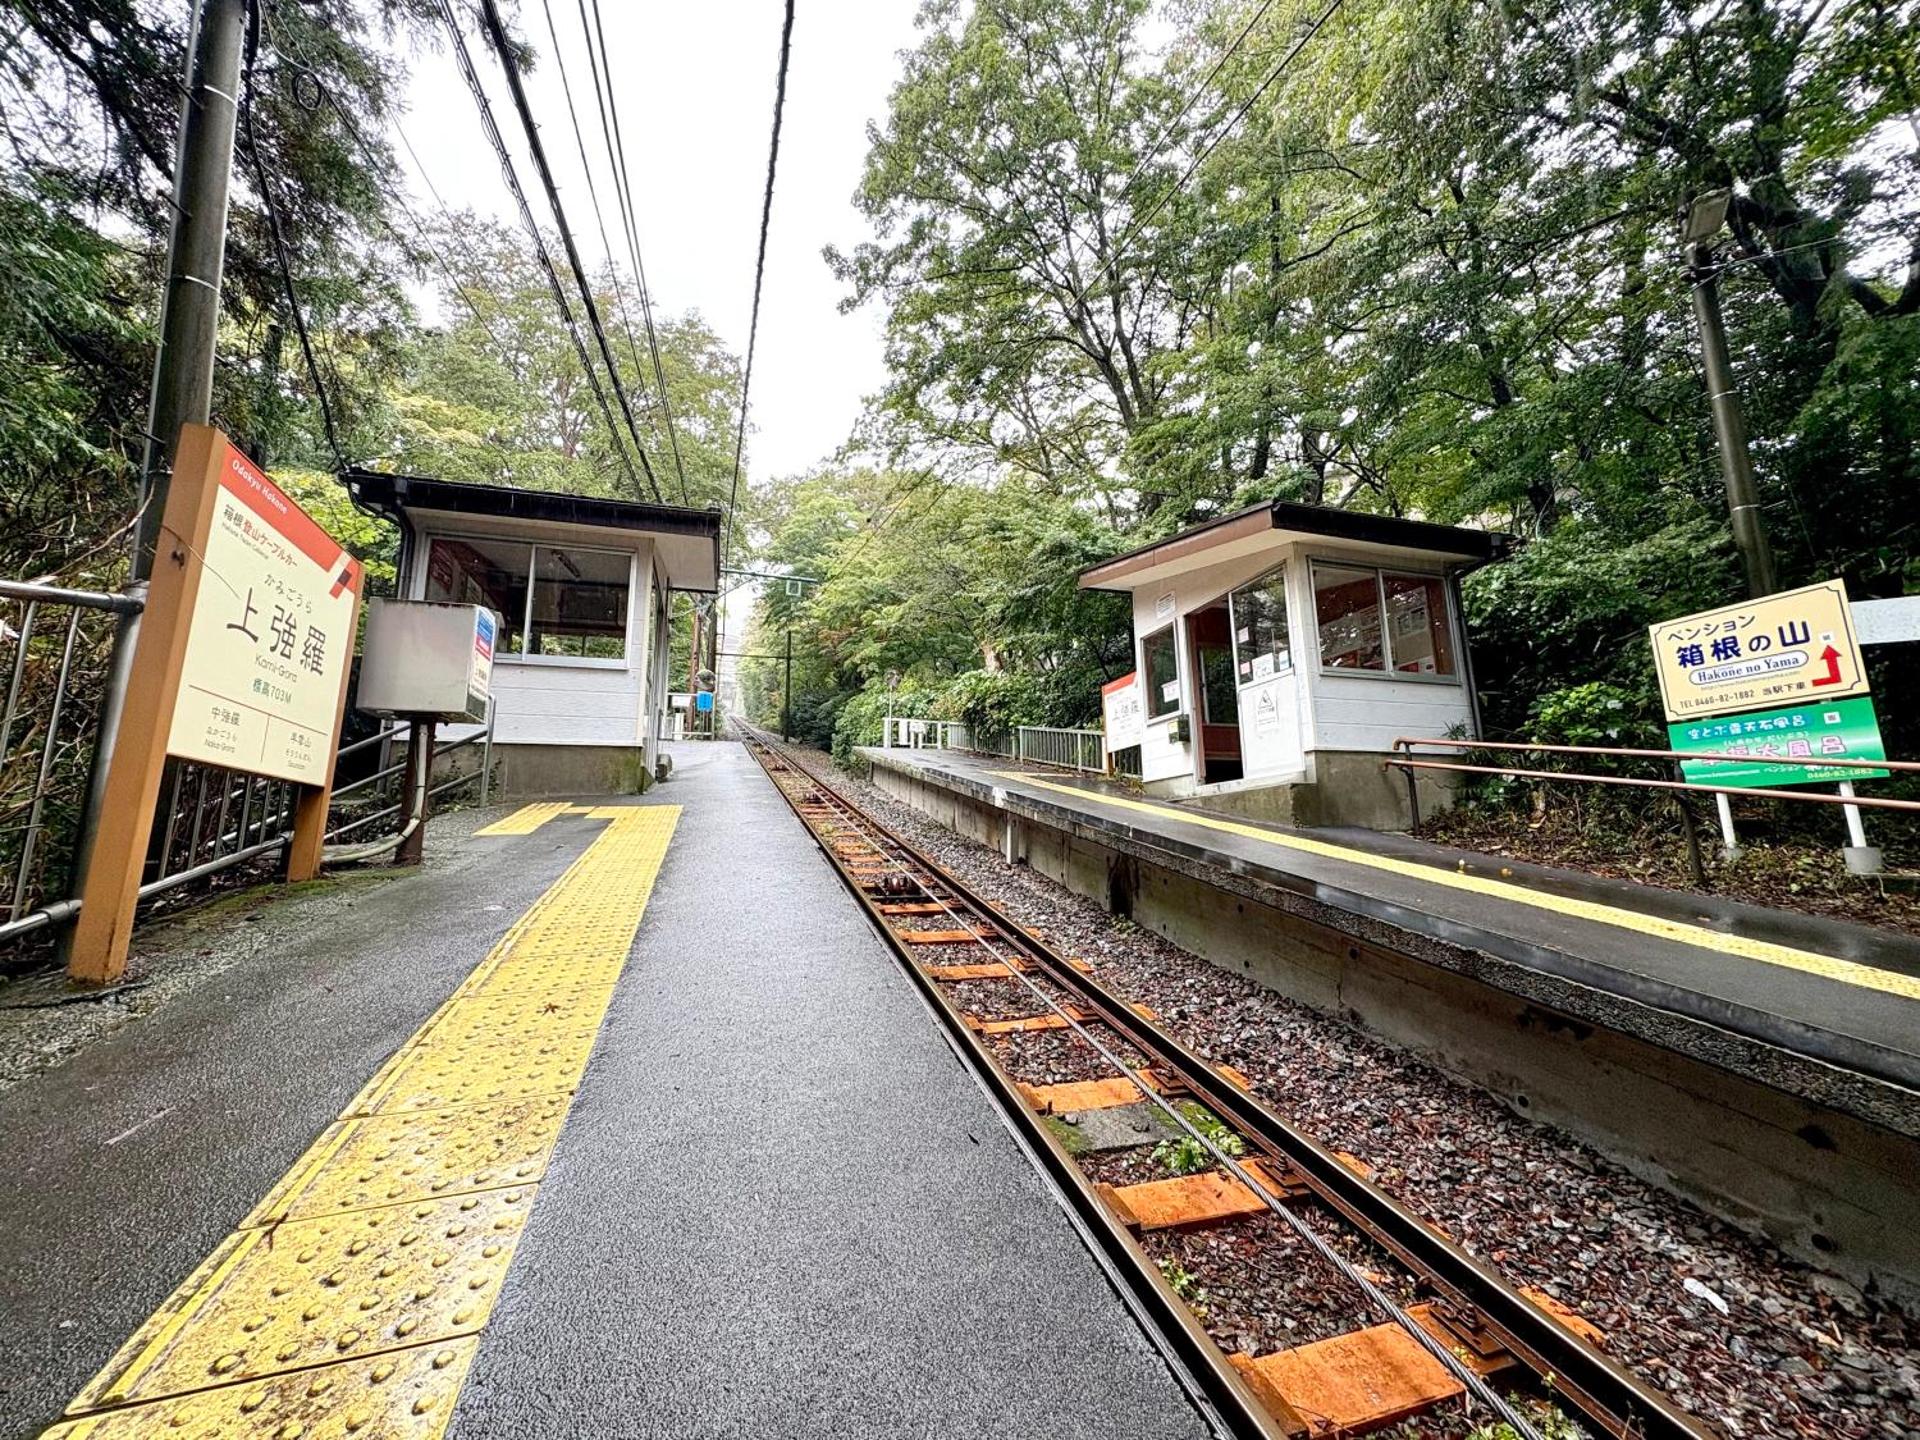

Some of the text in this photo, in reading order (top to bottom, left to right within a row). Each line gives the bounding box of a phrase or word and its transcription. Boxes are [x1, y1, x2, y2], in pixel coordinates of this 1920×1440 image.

[232, 459, 288, 515] Odakyu Hakone
[224, 503, 298, 568] 箱根登山ケーブルカー
[264, 573, 312, 614] かみごうら
[226, 586, 326, 677] 上強羅
[1668, 616, 1755, 640] ペンション
[1675, 620, 1811, 669] 箱根の山
[254, 653, 298, 683] Kami-Gora
[1697, 665, 1743, 682] Hakone
[1746, 664, 1762, 673] no
[1763, 656, 1800, 670] Yama
[1679, 698, 1694, 710] TEL
[1694, 689, 1755, 707] 0460-82-1882
